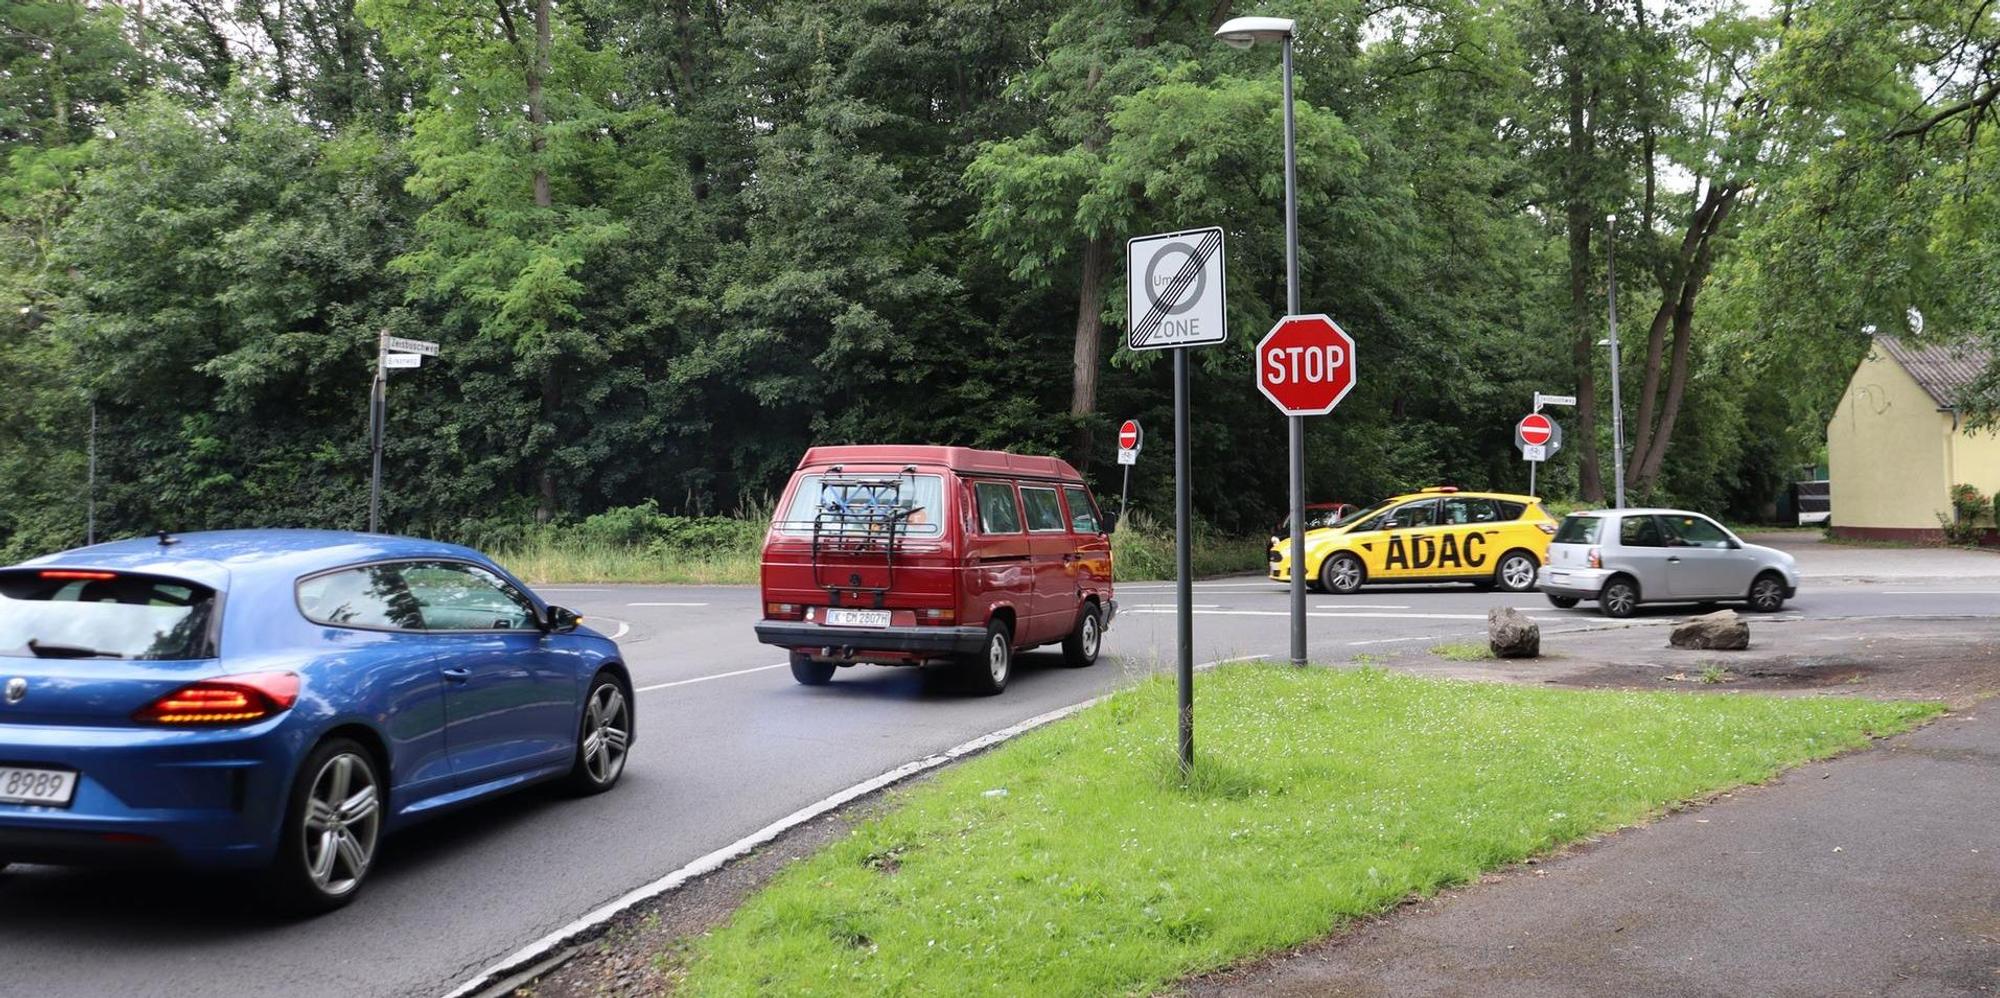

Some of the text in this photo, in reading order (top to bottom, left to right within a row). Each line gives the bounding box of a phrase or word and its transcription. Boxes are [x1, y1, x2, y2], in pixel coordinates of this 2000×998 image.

[1153, 318, 1200, 339] ZONE
[1267, 345, 1344, 385] STOP
[1384, 531, 1487, 570] ADAC
[6, 771, 65, 798] 8989
